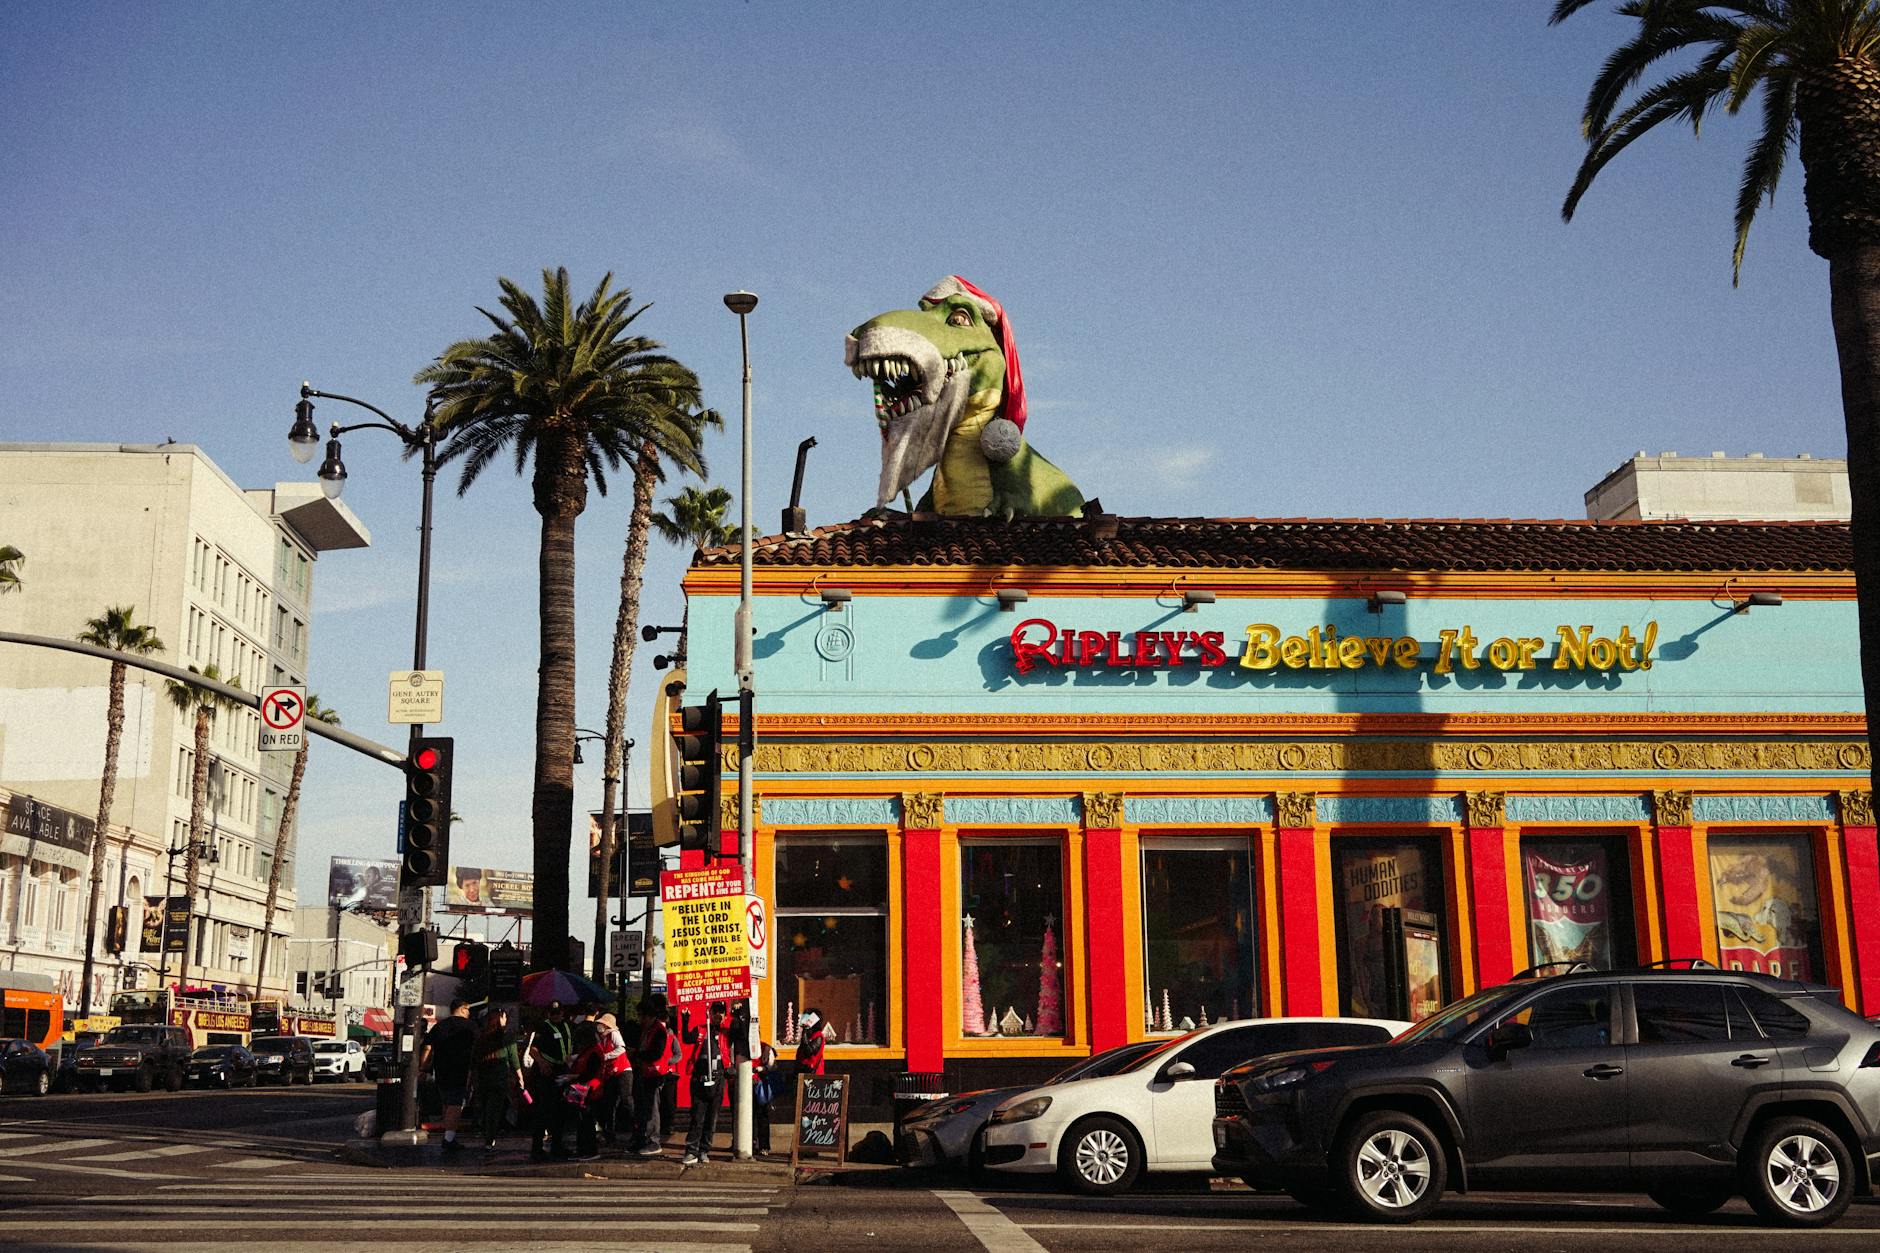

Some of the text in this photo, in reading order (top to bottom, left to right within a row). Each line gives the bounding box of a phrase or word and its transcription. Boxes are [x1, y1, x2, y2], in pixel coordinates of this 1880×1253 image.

[1011, 618, 1658, 675] RIPLEY'S Believe It or Not!
[262, 734, 299, 745] ON RED
[11, 815, 60, 840] AVALABLE
[1350, 858, 1396, 887] HUMAN
[493, 882, 519, 890] NICKEL
[665, 882, 716, 900] REPENT
[1364, 873, 1418, 901] ODDITIES
[672, 901, 731, 914] "BELIEVE IN
[681, 913, 729, 926] THE LORD
[672, 923, 743, 938] JESUS CHRIST,
[673, 934, 741, 948] AND YOU WILL BE
[694, 946, 729, 957] SAVED.
[614, 953, 639, 967] 25
[756, 956, 765, 969] RED
[676, 972, 703, 981] BEHOLD,
[704, 970, 720, 978] NOW
[677, 986, 704, 995] BEHOLD,
[723, 983, 730, 991] IS
[683, 979, 714, 988] ACCEPTED
[680, 994, 693, 1002] DAY
[695, 992, 703, 1000] OF
[216, 1015, 224, 1027] LOS
[225, 1015, 245, 1029] ANGELES
[824, 1083, 839, 1098] the
[803, 1100, 840, 1115] season
[811, 1115, 828, 1129] for
